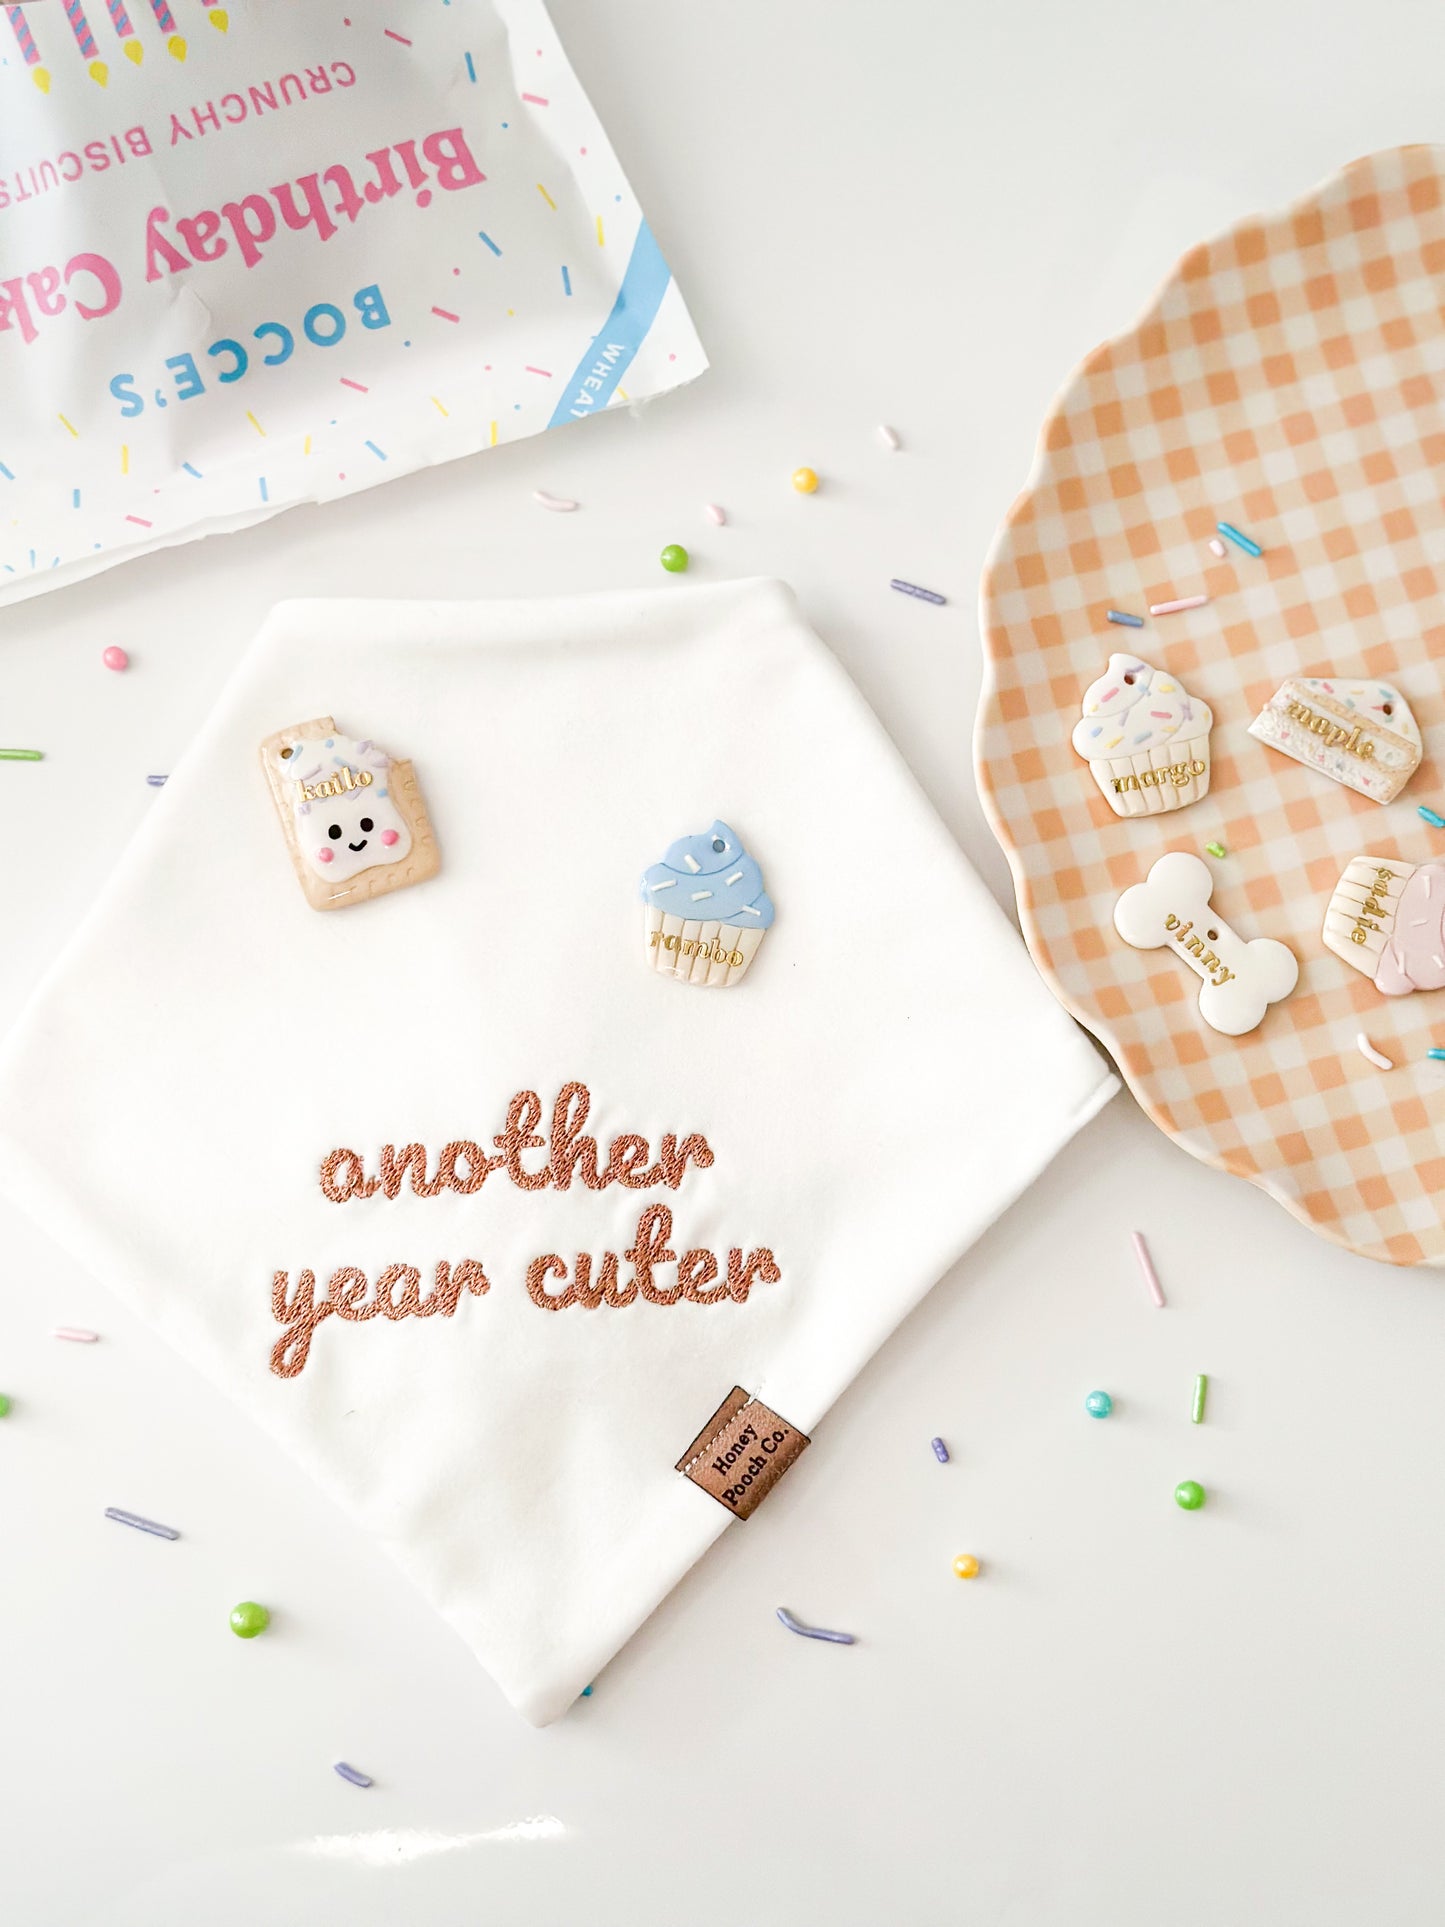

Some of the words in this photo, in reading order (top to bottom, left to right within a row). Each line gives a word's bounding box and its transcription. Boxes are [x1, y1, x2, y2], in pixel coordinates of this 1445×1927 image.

[170, 61, 358, 146] CRUNCHY
[0, 126, 153, 208] BISCUITS
[145, 127, 487, 283] Birthday
[109, 283, 392, 418] BOCCE'S
[1286, 699, 1376, 762] maple
[296, 766, 373, 803] kailo
[1110, 758, 1206, 794] margo
[1351, 867, 1393, 946] sadie
[649, 927, 745, 969] rambo
[1163, 913, 1236, 987] vinny
[319, 1081, 716, 1203] another
[269, 1257, 492, 1379] year
[525, 1203, 782, 1311] cuter
[711, 1423, 759, 1477] Honey
[721, 1455, 768, 1508] Pooch
[760, 1428, 790, 1455] Co.
